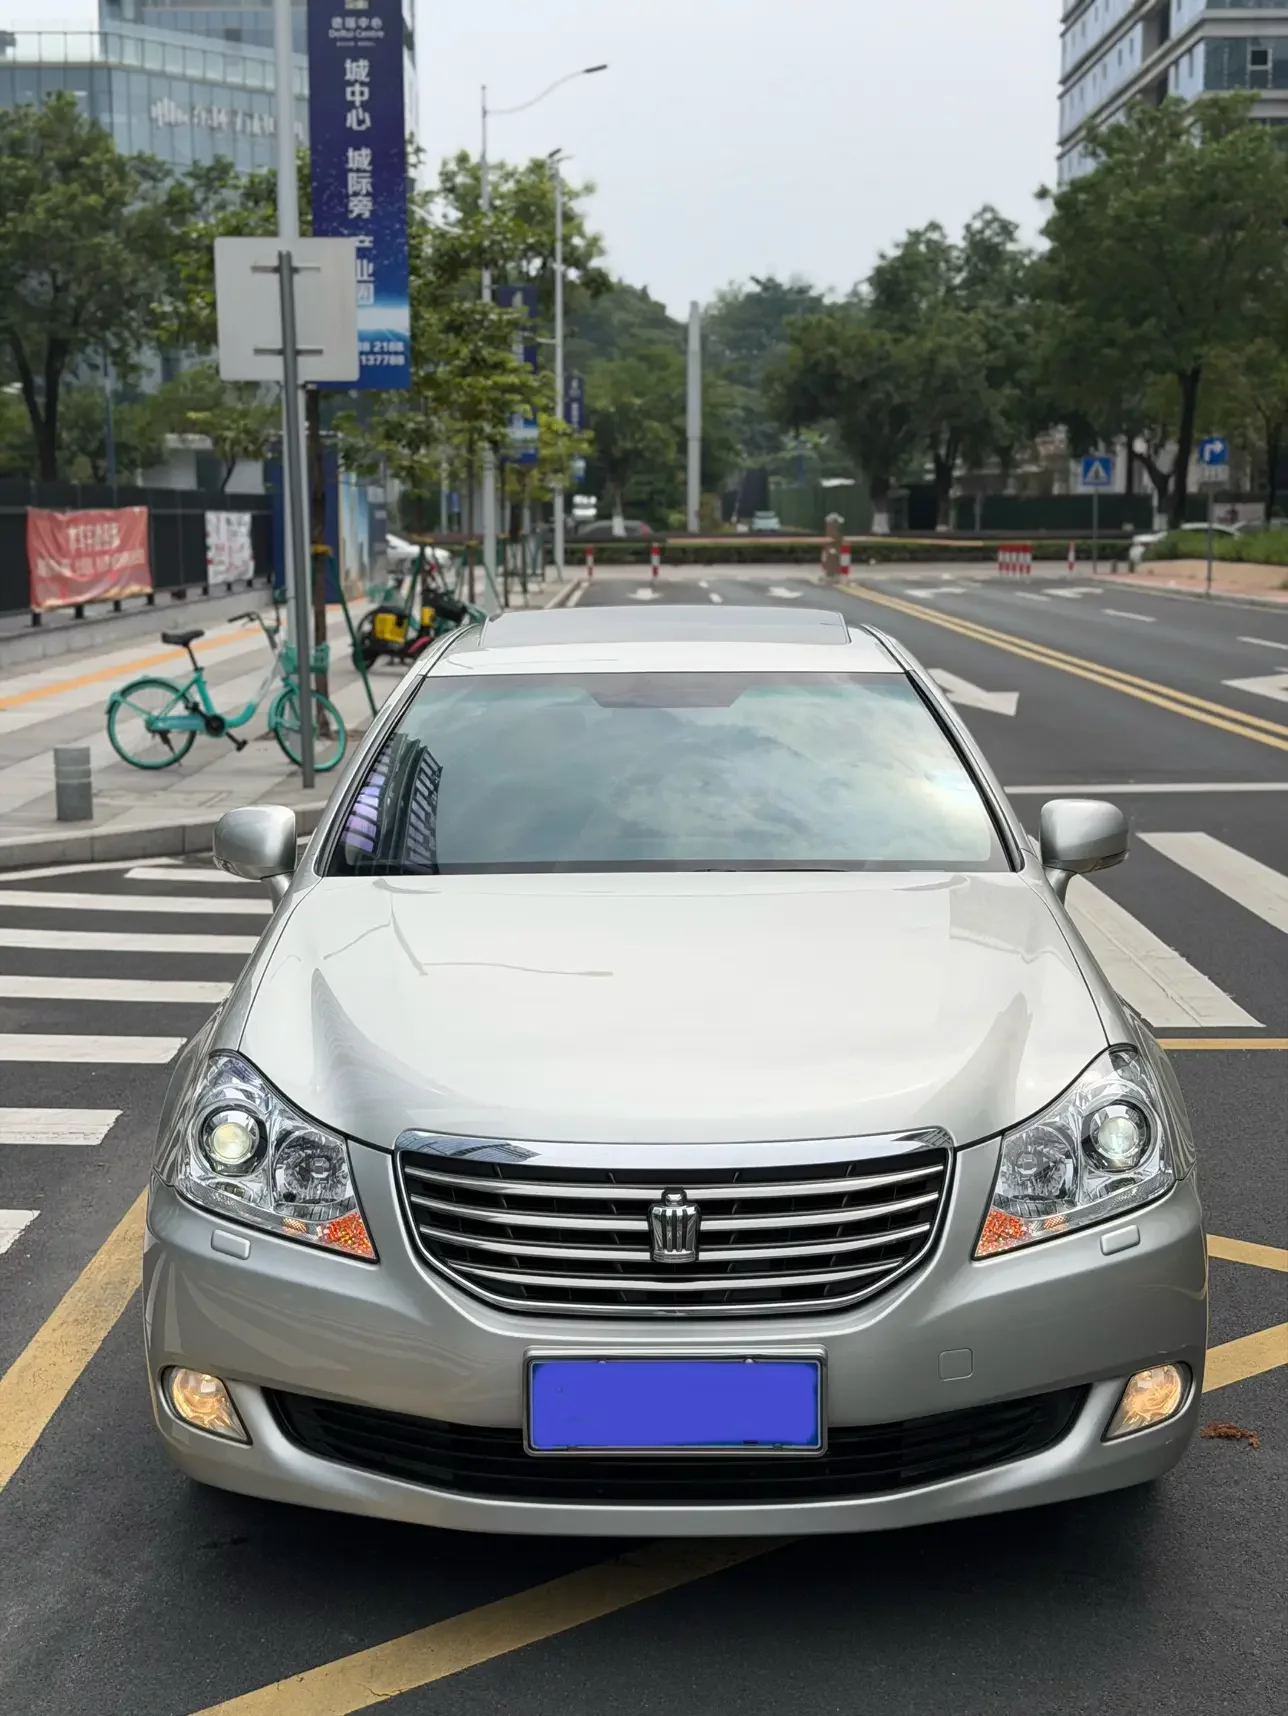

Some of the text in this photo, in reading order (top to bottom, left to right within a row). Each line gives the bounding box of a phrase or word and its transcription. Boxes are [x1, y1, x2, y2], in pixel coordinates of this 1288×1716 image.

[344, 58, 371, 131] 城中心
[345, 147, 373, 219] 城际旁
